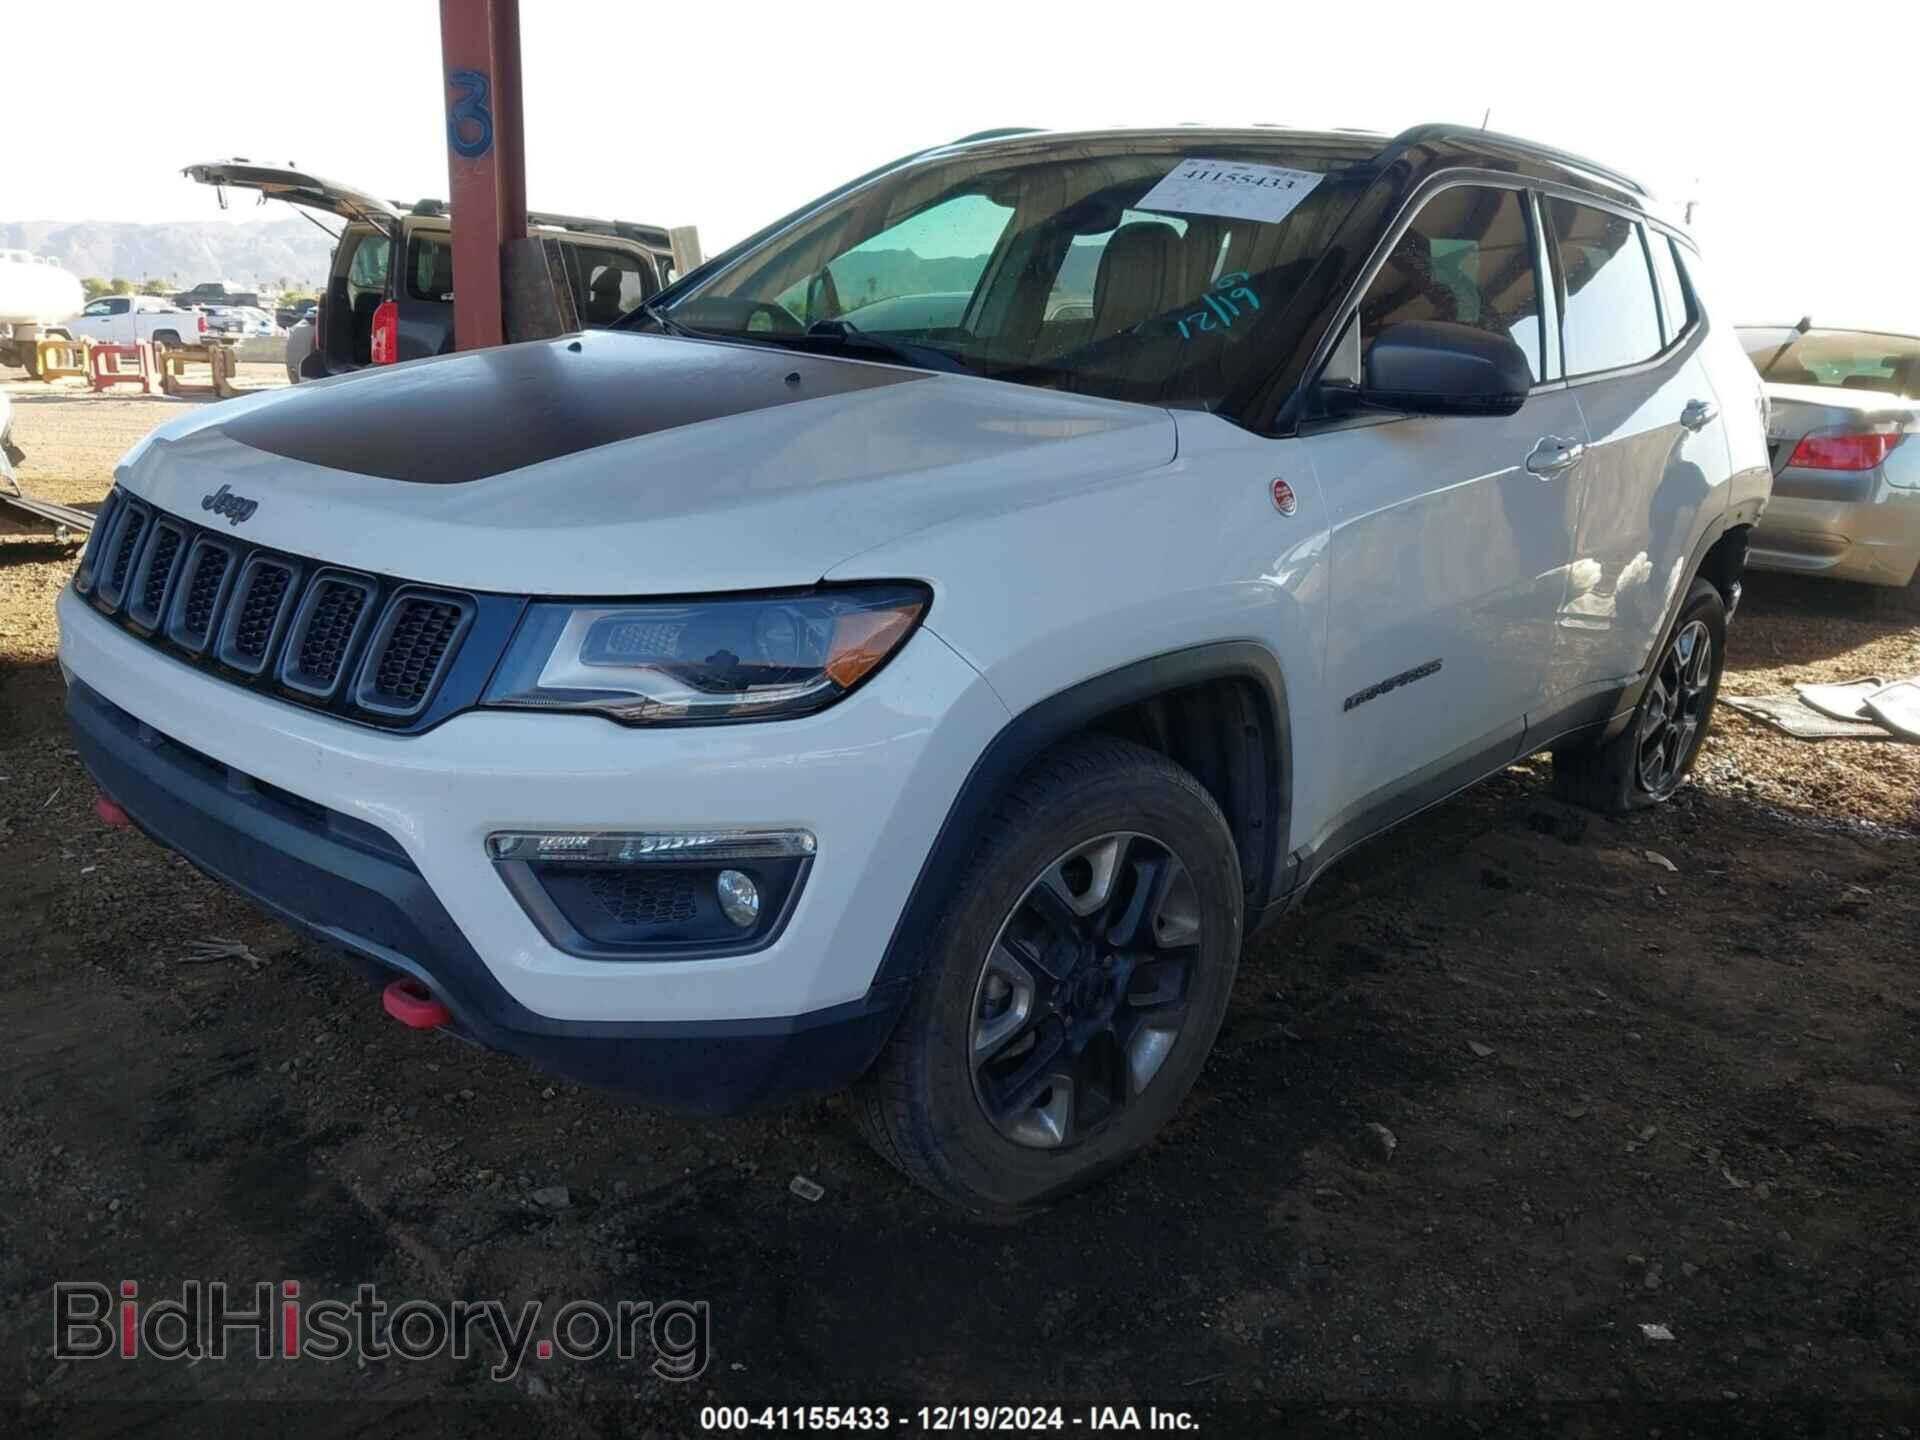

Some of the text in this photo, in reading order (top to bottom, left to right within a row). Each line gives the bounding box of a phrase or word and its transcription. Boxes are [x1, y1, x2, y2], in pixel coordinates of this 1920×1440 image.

[1183, 169, 1296, 191] 41155433
[1177, 287, 1261, 339] 12/19
[201, 484, 259, 526] Jeep
